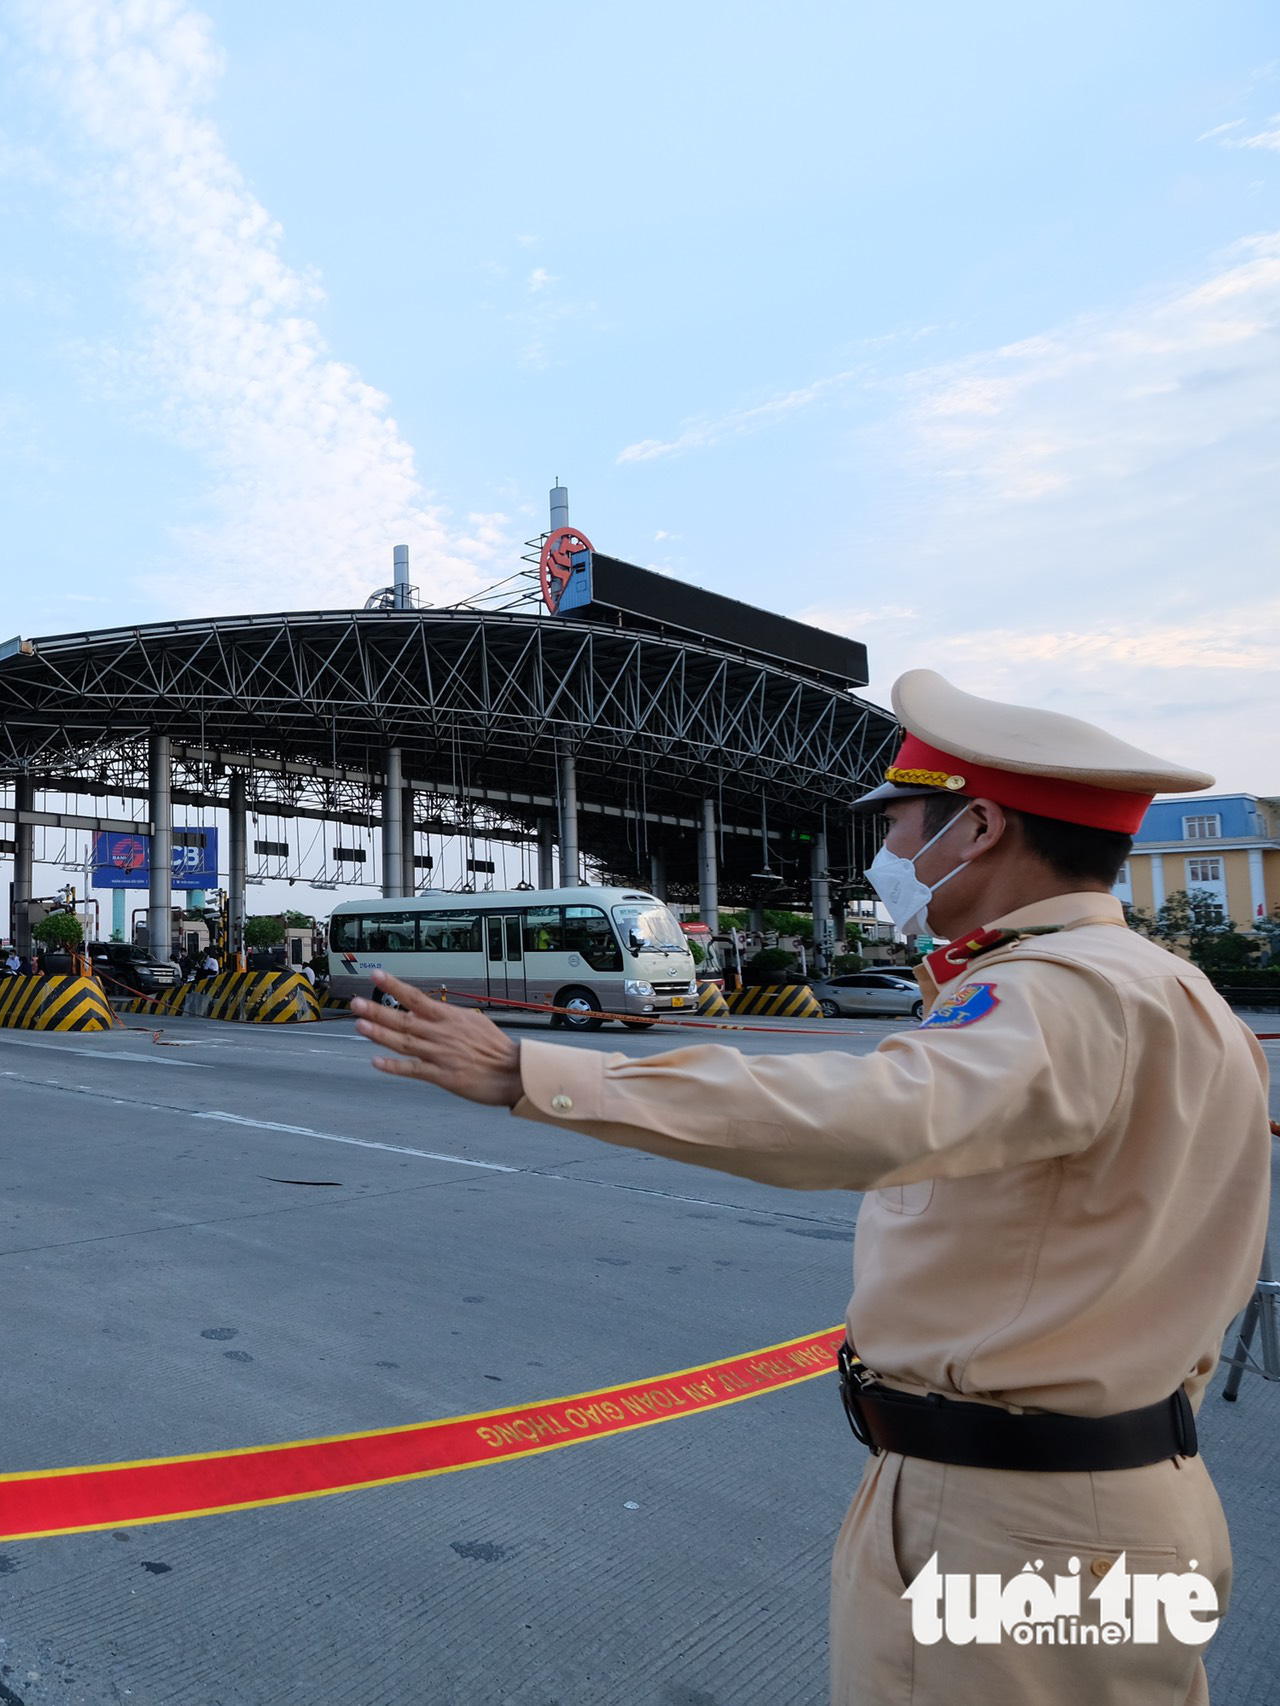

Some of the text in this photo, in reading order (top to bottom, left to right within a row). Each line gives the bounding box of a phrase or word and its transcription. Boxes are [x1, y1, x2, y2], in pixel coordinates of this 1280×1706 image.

[619, 1387, 687, 1416] TOÀN
[682, 1379, 717, 1403] AN
[565, 1402, 625, 1428] GIAO
[476, 1413, 571, 1447] THÔNG
